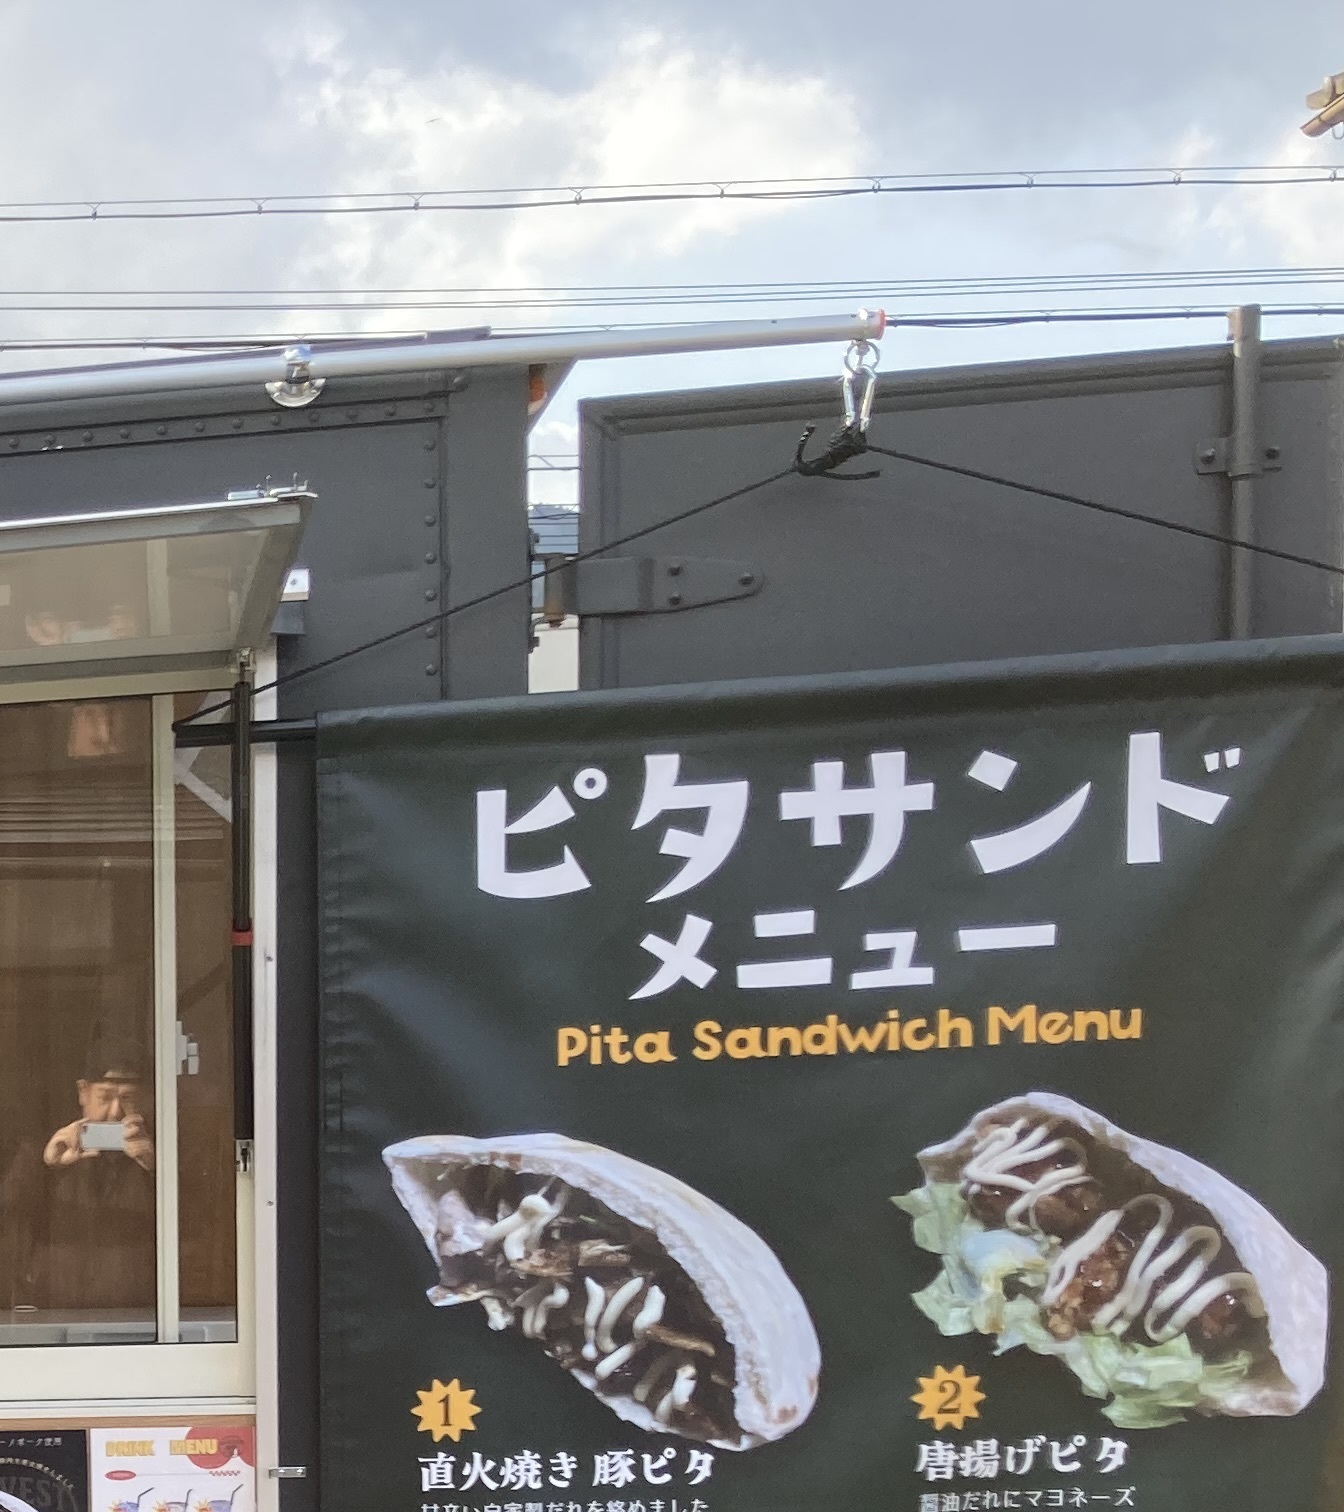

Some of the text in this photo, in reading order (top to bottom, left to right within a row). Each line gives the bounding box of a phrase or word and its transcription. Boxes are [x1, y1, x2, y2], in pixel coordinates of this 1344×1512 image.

[476, 730, 1243, 904] ピタサンド
[628, 910, 1057, 1001] メニュー
[556, 1005, 1143, 1067] Pita Sandwich Menu
[439, 1394, 452, 1427] 1
[936, 1380, 962, 1415] 2
[169, 1438, 218, 1456] MENU
[418, 1447, 715, 1492] 直火焼き 豚ピタ
[914, 1434, 1129, 1482] 唐揚げピタ
